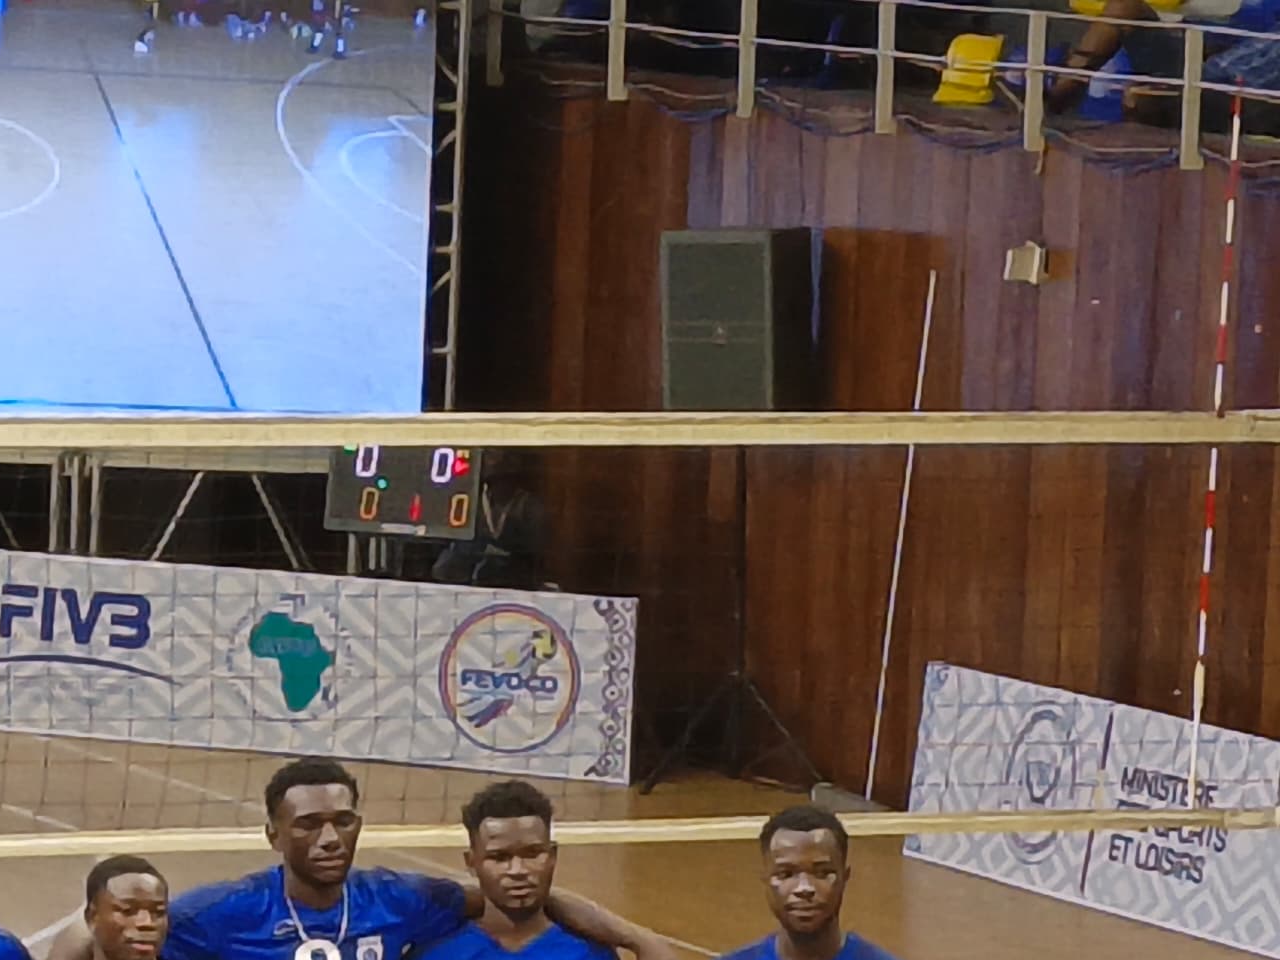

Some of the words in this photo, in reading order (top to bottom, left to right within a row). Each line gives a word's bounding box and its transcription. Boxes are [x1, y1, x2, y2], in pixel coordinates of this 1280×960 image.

[355, 445, 379, 477] 0
[431, 448, 454, 483] 0
[360, 487, 379, 520] 0
[449, 494, 469, 526] 0
[1109, 834, 1134, 864] ET
